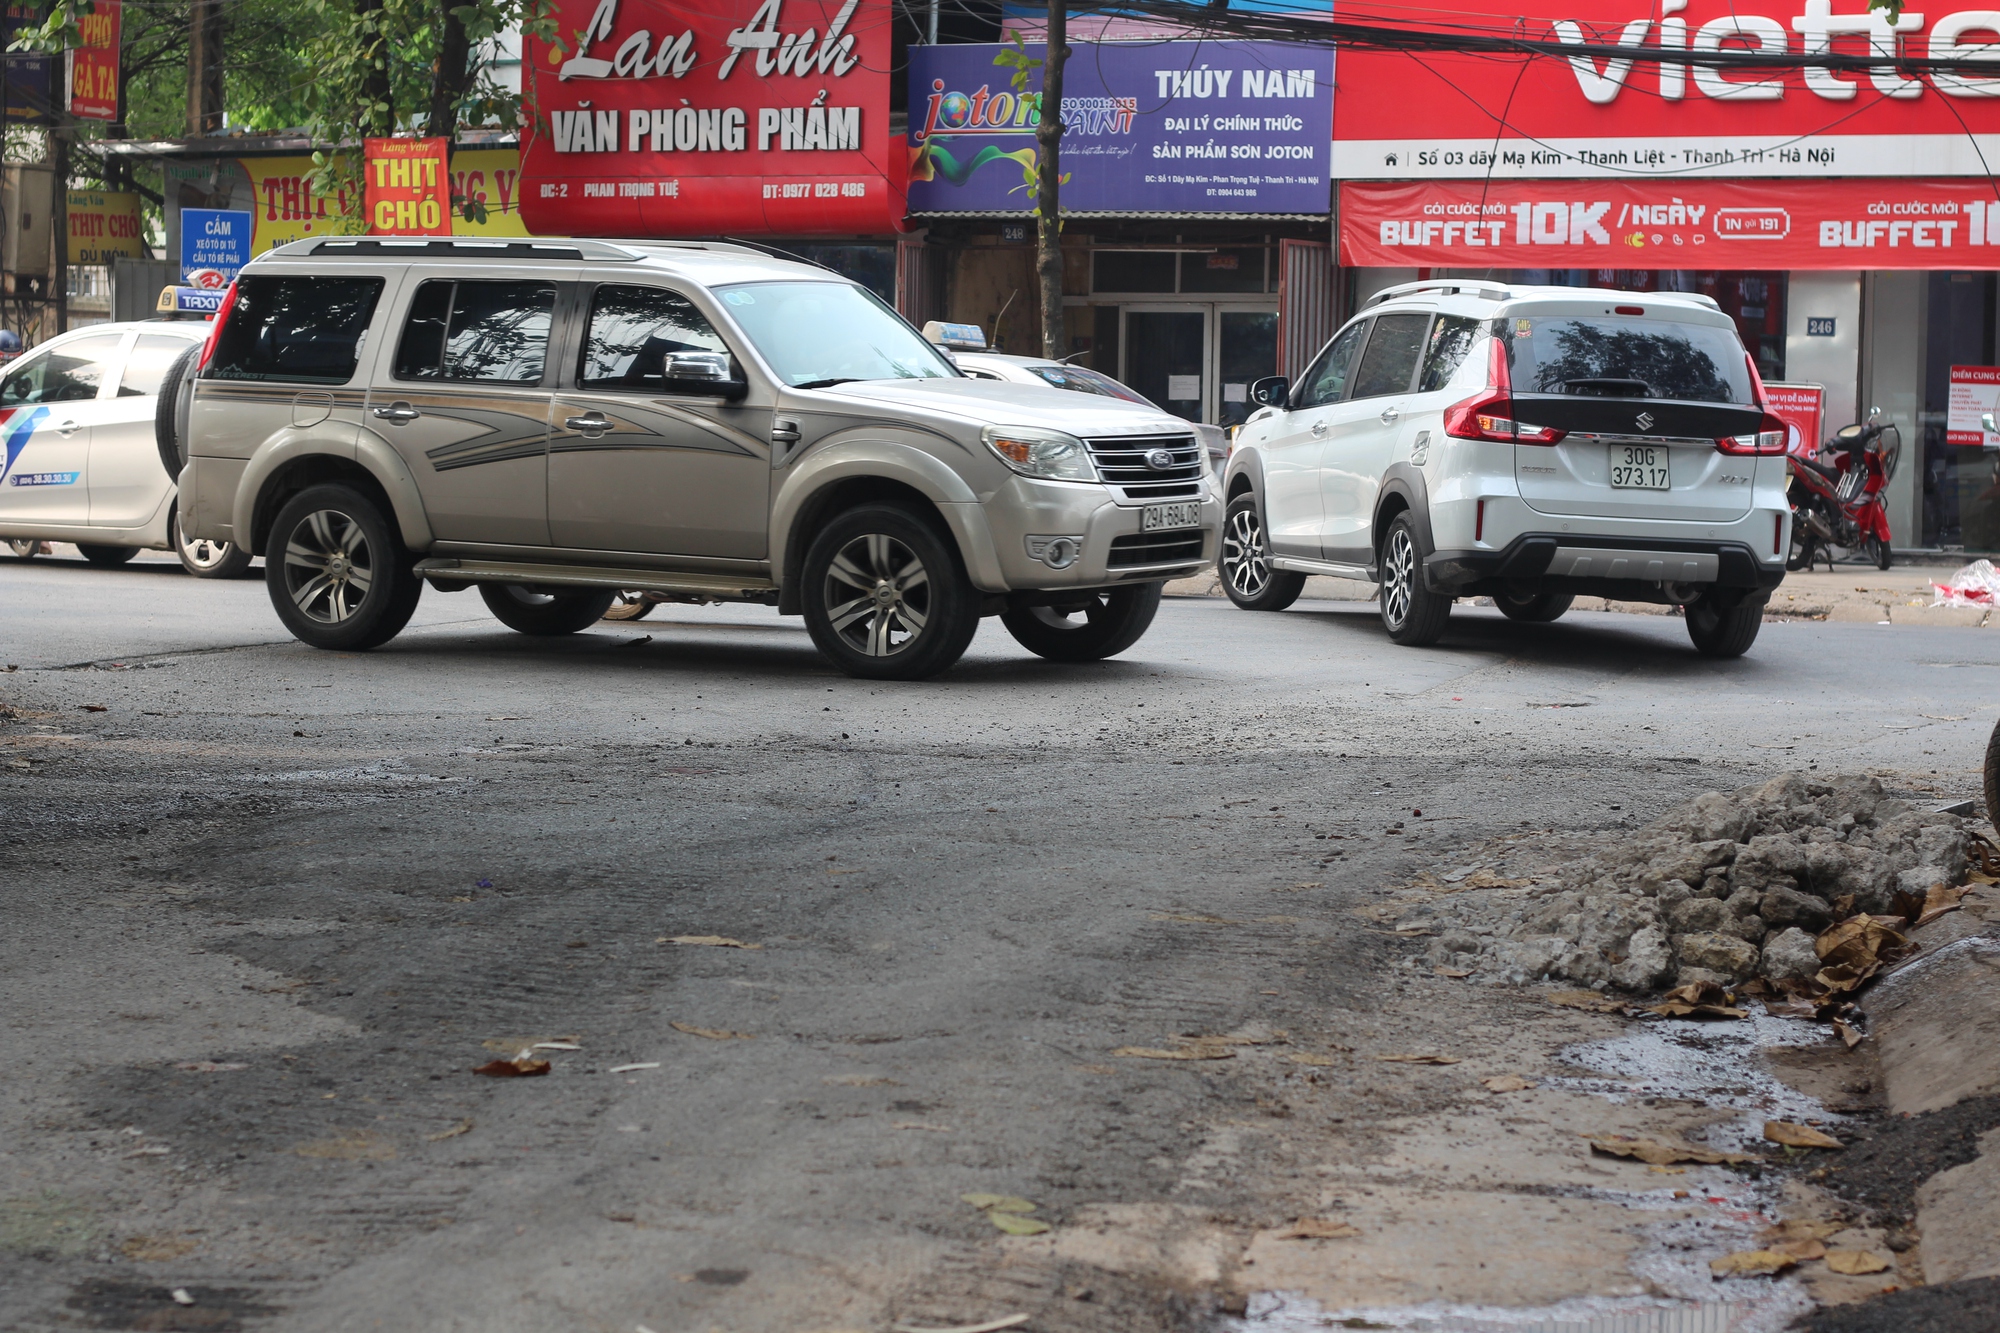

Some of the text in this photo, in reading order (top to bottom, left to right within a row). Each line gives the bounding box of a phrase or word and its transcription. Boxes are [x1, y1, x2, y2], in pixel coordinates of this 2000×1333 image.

[558, 0, 858, 81] Lan Anh
[74, 53, 116, 101] GÀ TA
[1155, 64, 1315, 98] THÚY NAM
[1061, 98, 1077, 109] SO
[551, 89, 861, 152] VĂN PHÒNG PHẨM
[1164, 114, 1303, 134] ĐẠI LÝ CHÍNH THỨC
[1152, 138, 1314, 159] SẢN PHẨM SƠN JOTON
[1418, 148, 1439, 165] Số
[1444, 153, 1463, 165] 03
[1503, 151, 1525, 168] Mạ
[1532, 151, 1561, 165] Kim
[1579, 151, 1627, 165] Thanh
[1634, 149, 1665, 168] Liệt
[1683, 150, 1734, 164] Thanh
[1780, 149, 1801, 163] Hà
[1808, 149, 1835, 166] Nội
[371, 158, 440, 194] THỊT
[1213, 175, 1229, 183] Phan
[584, 183, 615, 197] PHAN
[619, 182, 654, 199] TRỌNG
[659, 179, 679, 199] TUỆ
[815, 183, 838, 197] 028
[841, 183, 865, 197] 486
[374, 194, 441, 230] CHÓ
[1447, 202, 1480, 215] CƯỚC
[1482, 202, 1506, 215] MỚI
[1893, 201, 1929, 215] CƯỚC
[1932, 201, 1958, 214] MỚI
[69, 208, 139, 243] THỊT CHÓ
[205, 215, 231, 235] CẤM
[1005, 228, 1024, 239] 248
[1380, 221, 1506, 246] BUFFET
[1511, 202, 1611, 245] 10K
[1760, 218, 1778, 230] 191
[1819, 221, 1958, 247] BUFFET
[80, 243, 97, 261] ĐỦ
[182, 296, 215, 309] TAXI
[1810, 321, 1832, 333] 246
[1973, 371, 1995, 380] CUNG
[1624, 447, 1655, 466] 30G
[1613, 467, 1667, 486] 373.17
[1145, 504, 1199, 528] 29A-684.08
